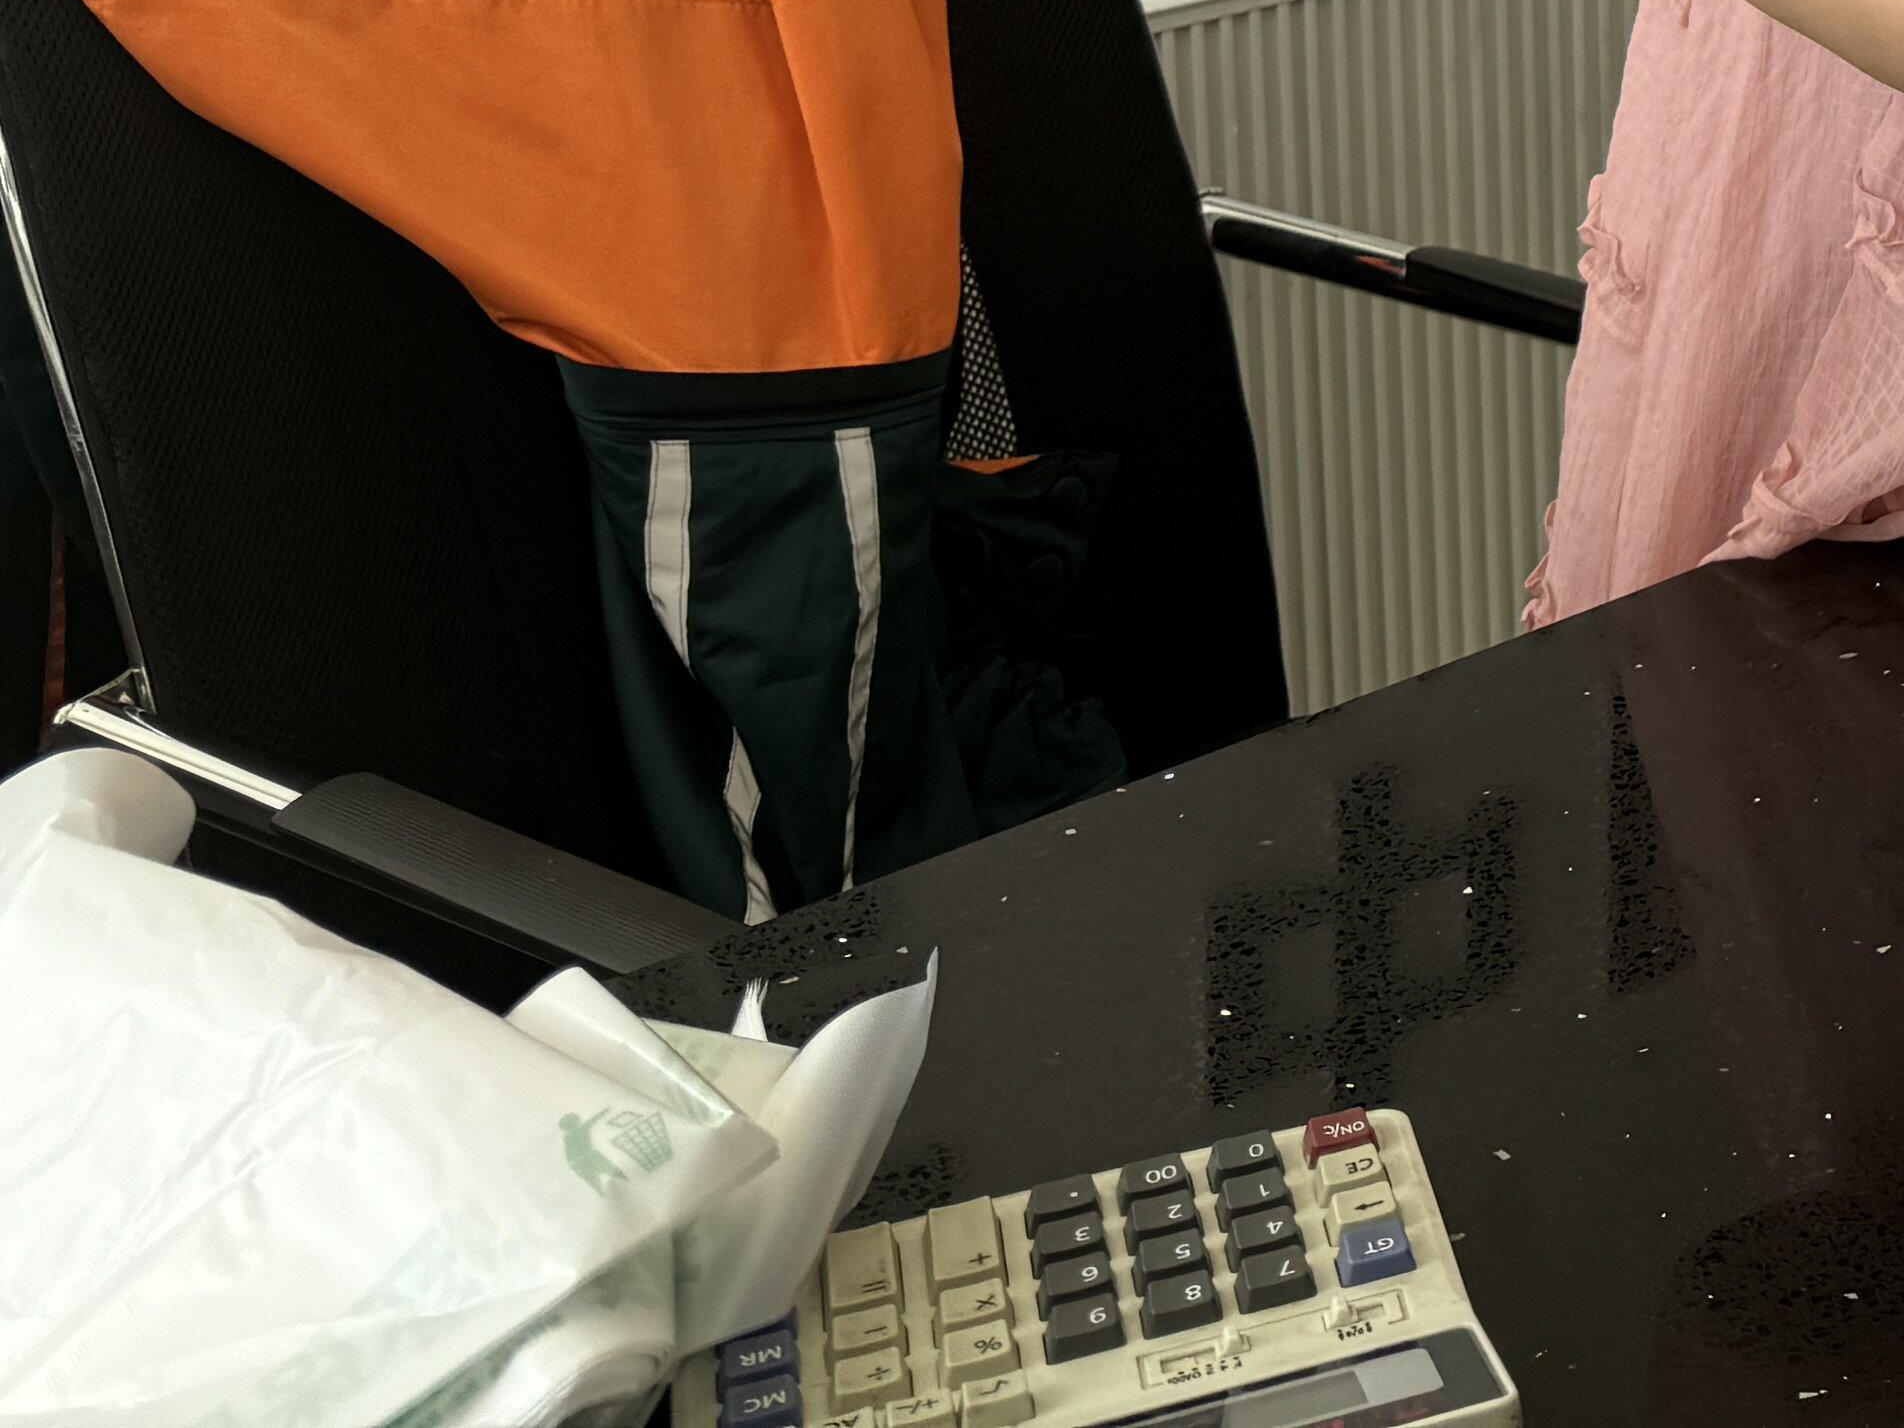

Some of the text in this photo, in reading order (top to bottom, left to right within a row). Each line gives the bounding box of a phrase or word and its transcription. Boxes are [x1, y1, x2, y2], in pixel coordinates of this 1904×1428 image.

[1323, 1119, 1366, 1138] ON/C
[1345, 1158, 1373, 1177] CE
[1365, 1236, 1396, 1256] GT
[741, 1345, 785, 1366] MR
[743, 1388, 786, 1412] MC
